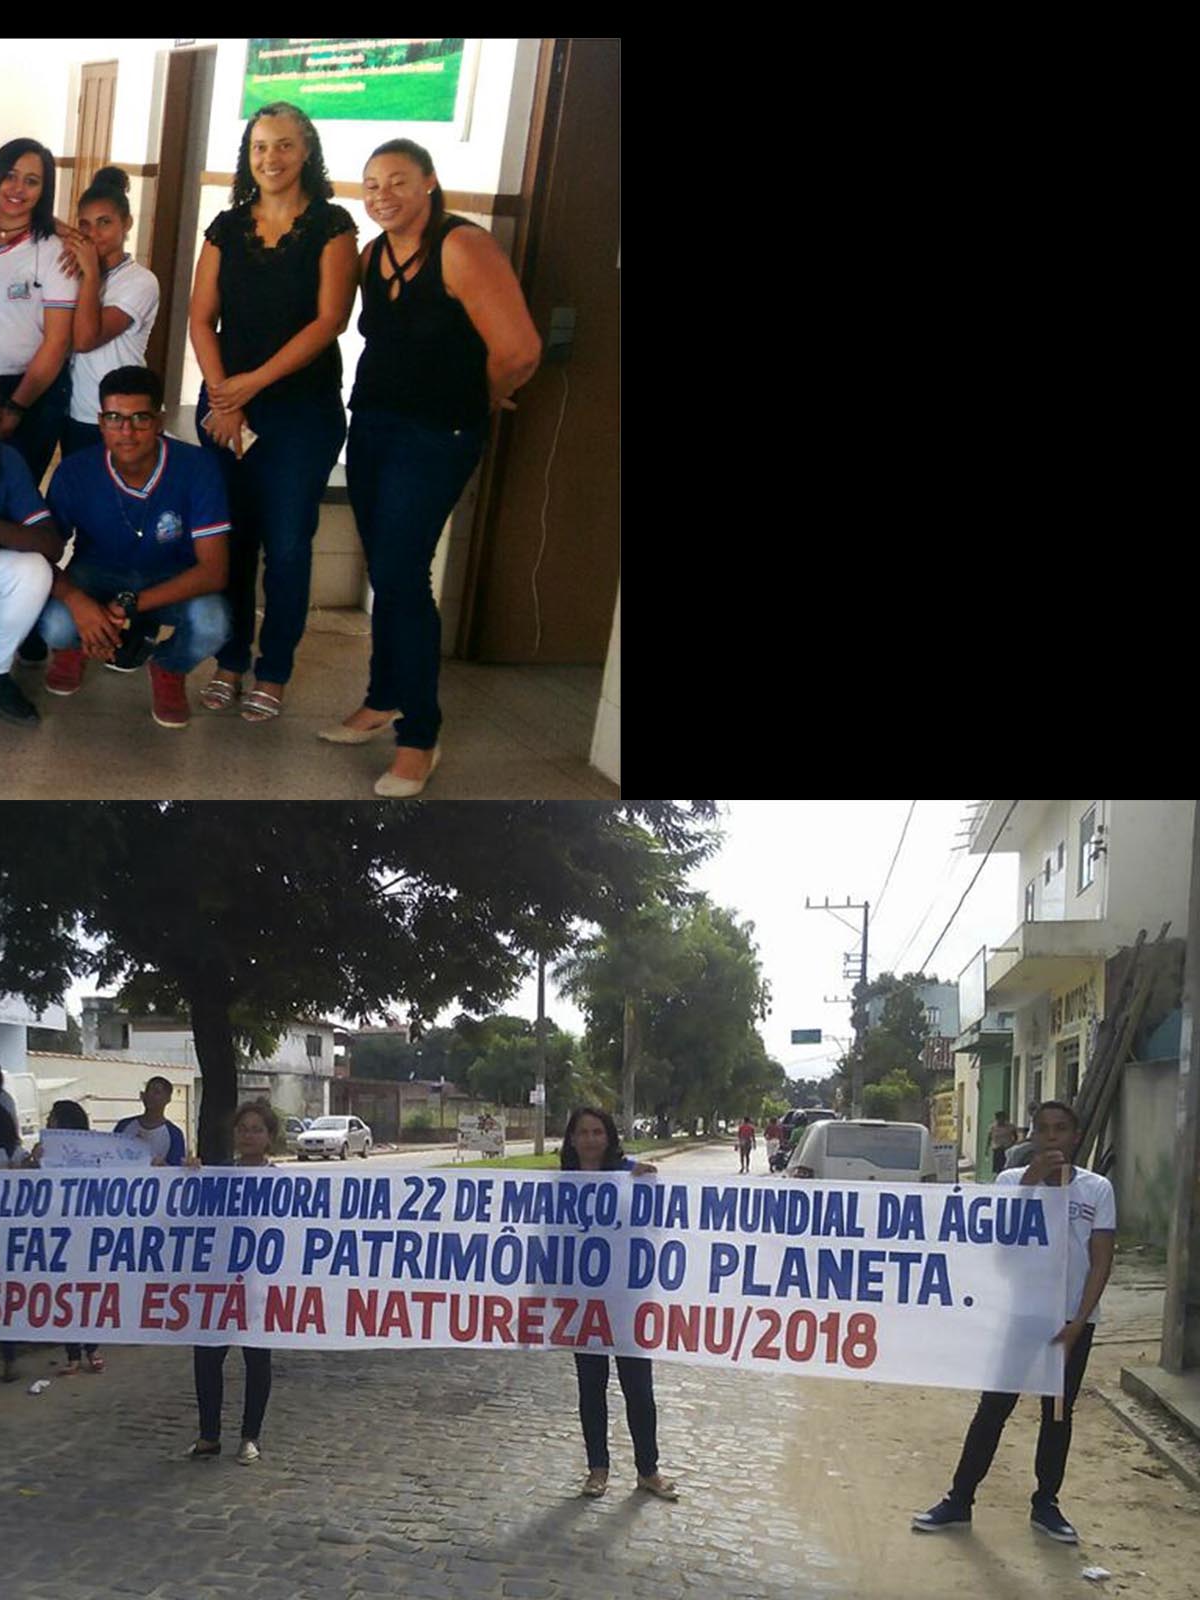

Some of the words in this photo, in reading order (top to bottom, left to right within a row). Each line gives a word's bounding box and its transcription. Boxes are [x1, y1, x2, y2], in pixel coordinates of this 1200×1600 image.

[60, 1177, 160, 1218] TINOCO
[165, 1176, 331, 1219] COMEMORA
[340, 1178, 392, 1220] DIA
[397, 1176, 447, 1222] 22
[454, 1179, 493, 1223] DE
[500, 1180, 623, 1233] MARÇO,
[630, 1184, 689, 1230] DIA
[699, 1186, 865, 1239] MUNDIAL
[877, 1192, 926, 1241] DA
[938, 1185, 1049, 1246] ÁGUA
[6, 1227, 72, 1273] FAZ
[88, 1226, 217, 1273] PARTE
[227, 1226, 286, 1276] DO
[301, 1226, 611, 1287] PATRIMÔNIO
[627, 1236, 687, 1292] DO
[139, 1274, 248, 1332] ESTÁ
[264, 1285, 327, 1334] NA
[345, 1288, 615, 1347] NATUREZA
[634, 1301, 877, 1369] ONU/2018
